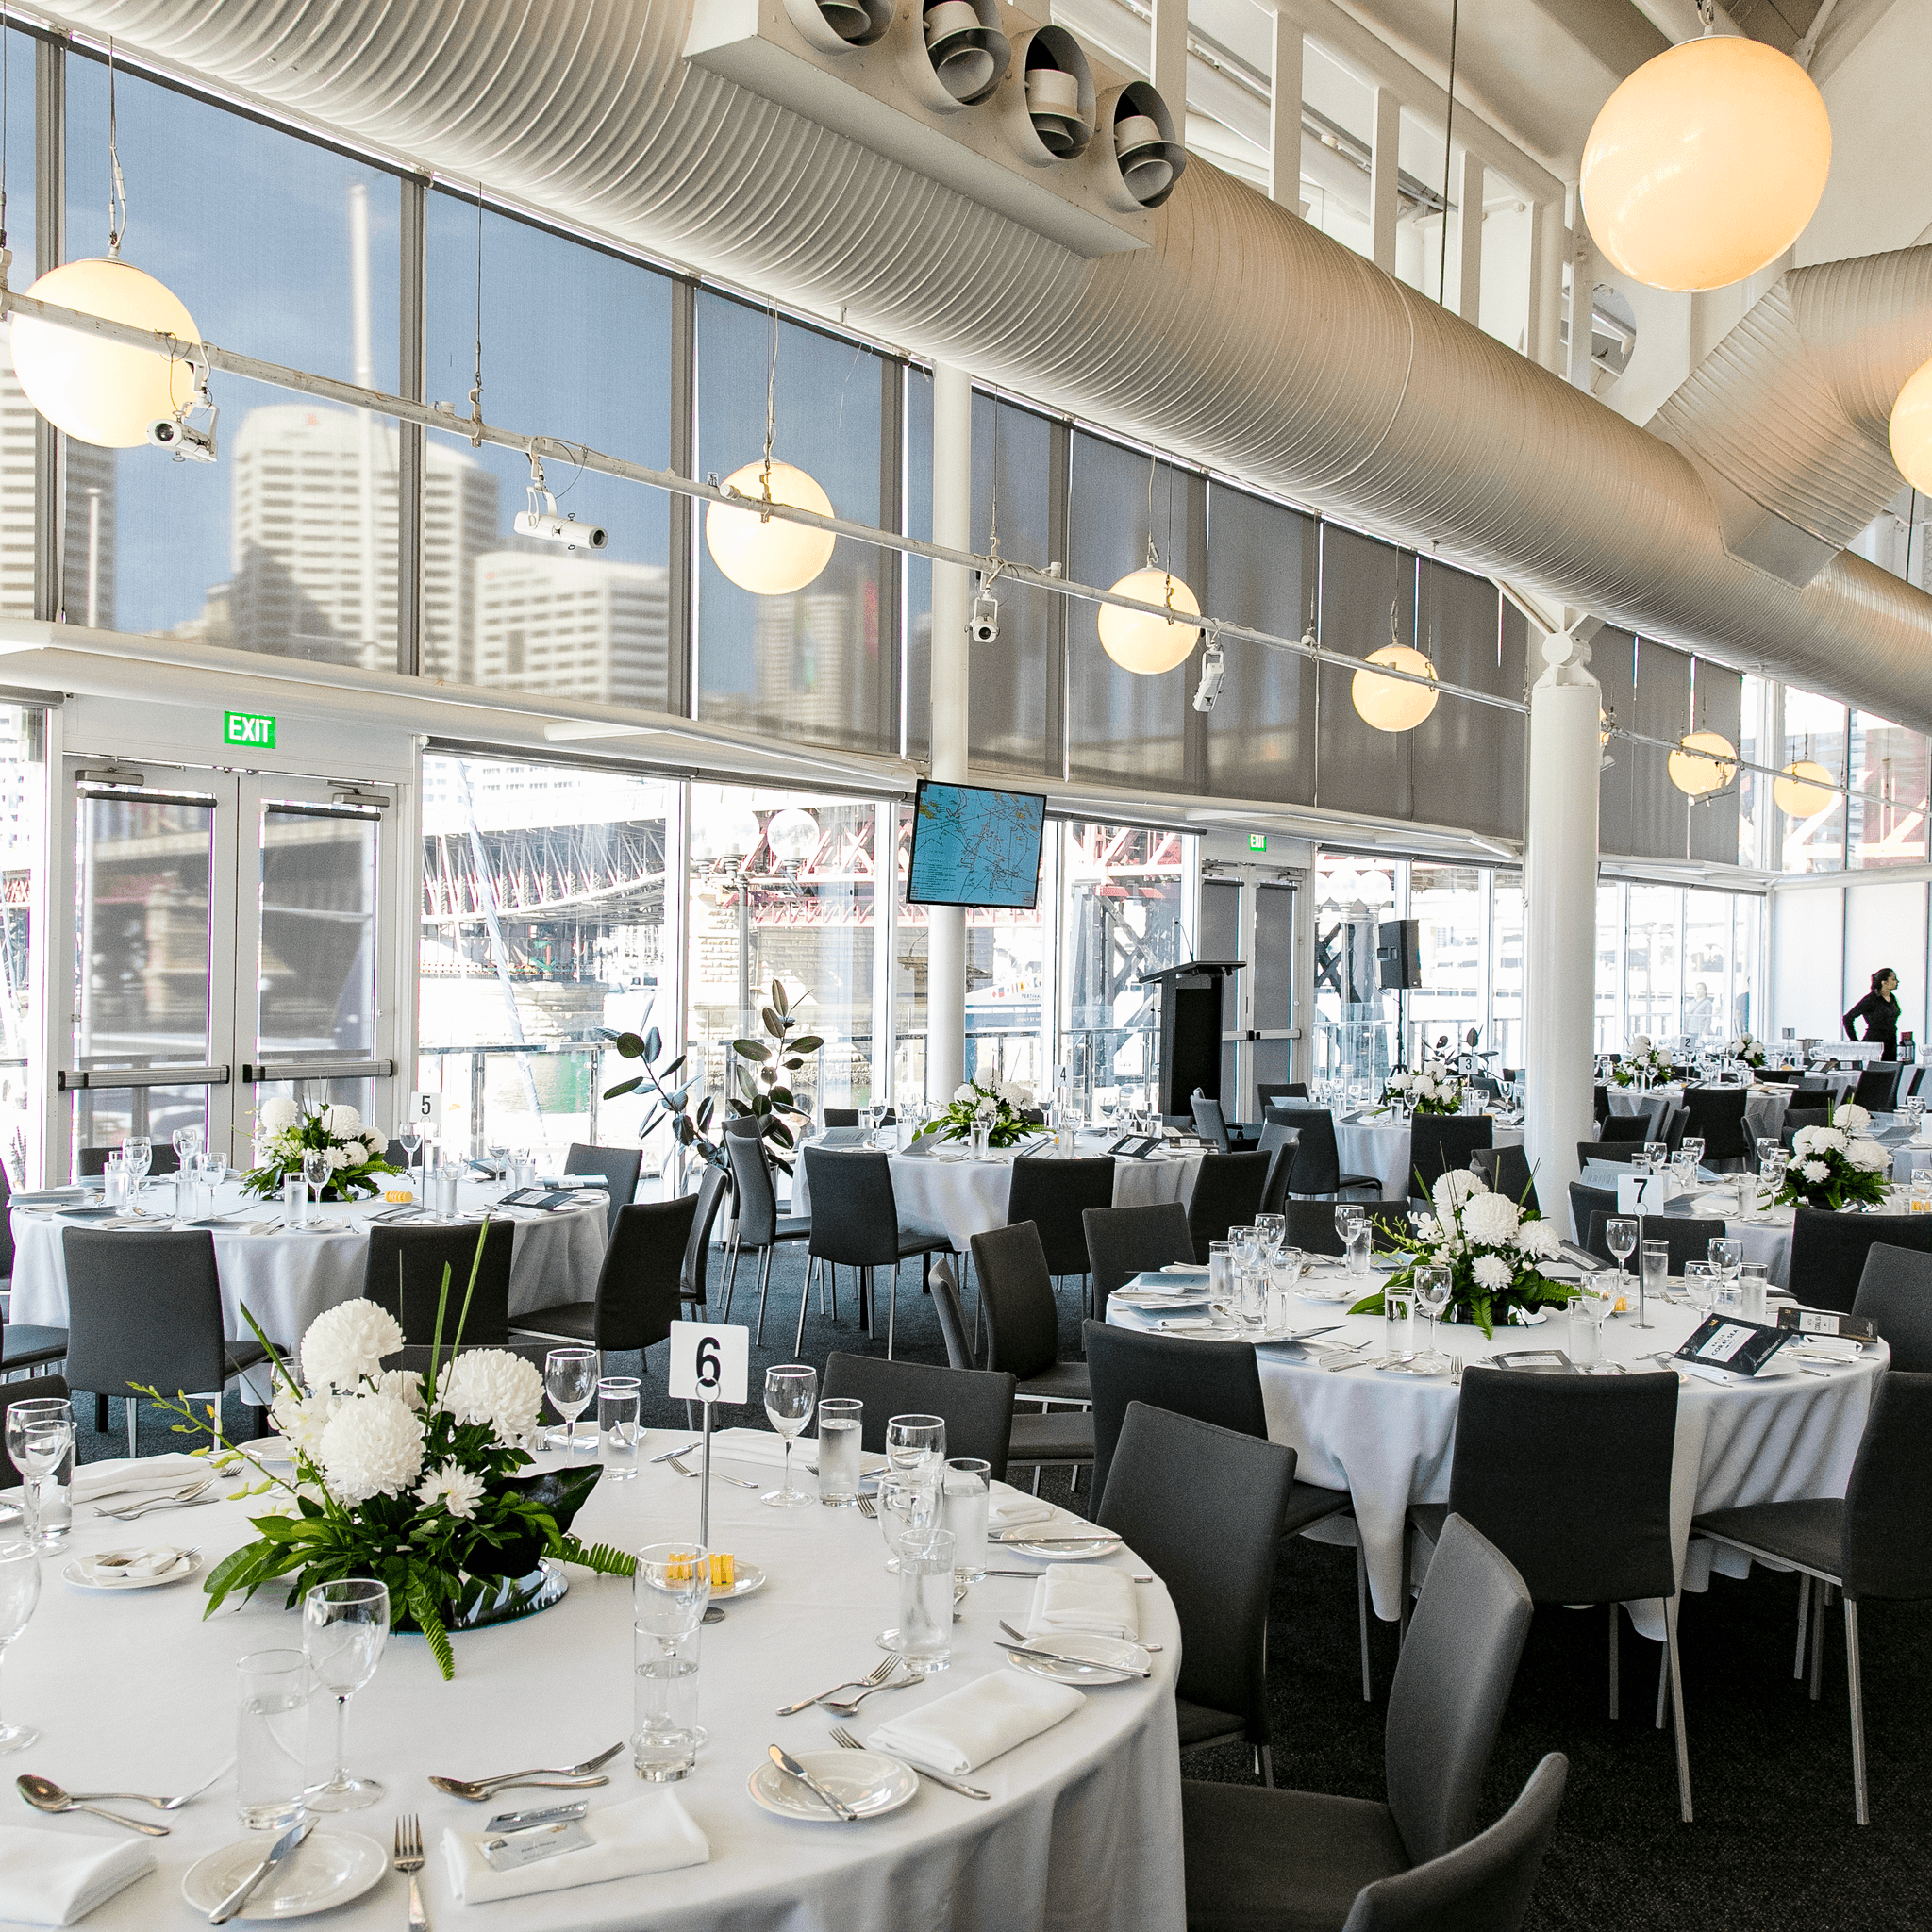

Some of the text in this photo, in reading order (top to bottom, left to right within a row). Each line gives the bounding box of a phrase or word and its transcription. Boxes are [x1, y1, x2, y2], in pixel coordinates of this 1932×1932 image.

[229, 715, 272, 743] EXIT
[1250, 834, 1265, 848] EXIT
[1685, 1038, 1690, 1047] 2
[1060, 1067, 1066, 1081] 4
[1465, 1058, 1472, 1070] 3
[422, 1095, 431, 1115] 5
[1633, 1178, 1648, 1203] 7
[1711, 1338, 1730, 1356] CORAL
[1727, 1329, 1739, 1340] SEA
[696, 1336, 721, 1388] 6
